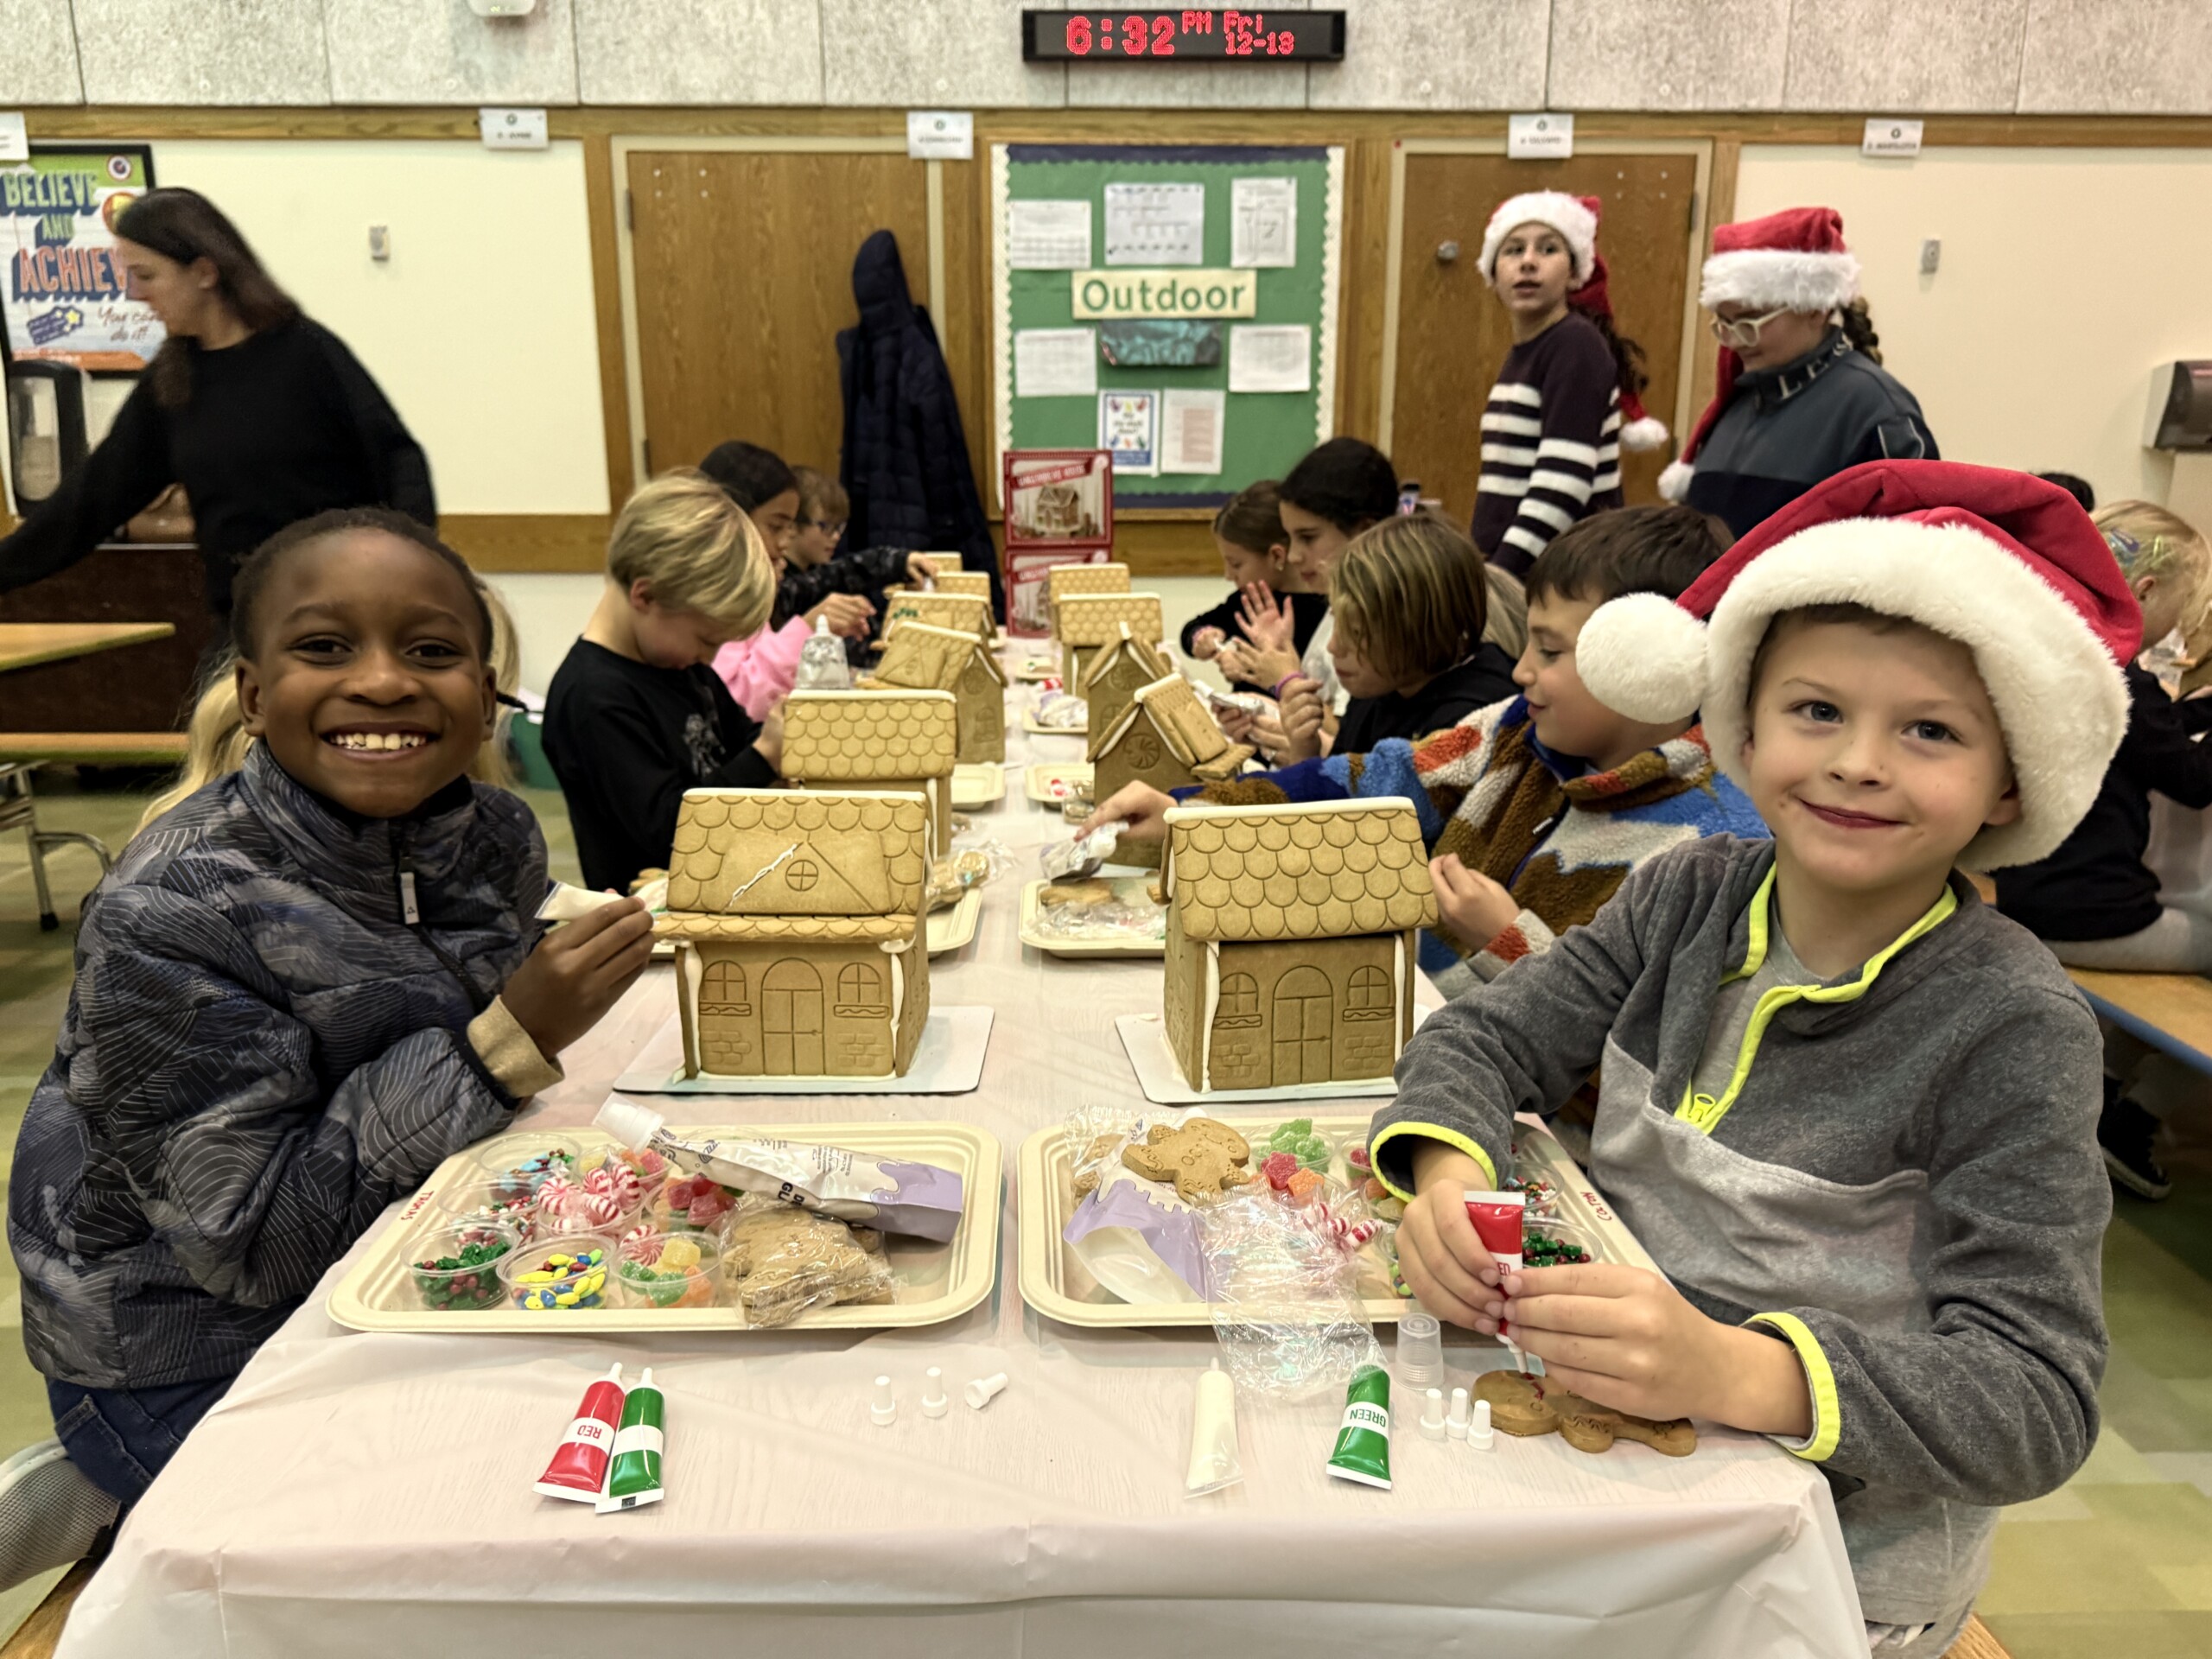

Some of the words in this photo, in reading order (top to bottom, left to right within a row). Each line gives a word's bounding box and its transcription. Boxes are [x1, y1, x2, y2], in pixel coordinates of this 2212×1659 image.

[1066, 16, 1175, 55] 6:32
[1181, 10, 1211, 35] PM
[1224, 10, 1263, 35] Fri
[1225, 31, 1294, 55] 12-13
[3, 172, 100, 208] BELIEVE
[41, 213, 75, 239] AND
[19, 245, 130, 294] ACHIEV
[1083, 279, 1246, 311] Outdoor
[1497, 1262, 1511, 1276] ED
[1349, 1408, 1387, 1427] GREEN
[577, 1424, 603, 1440] RED
